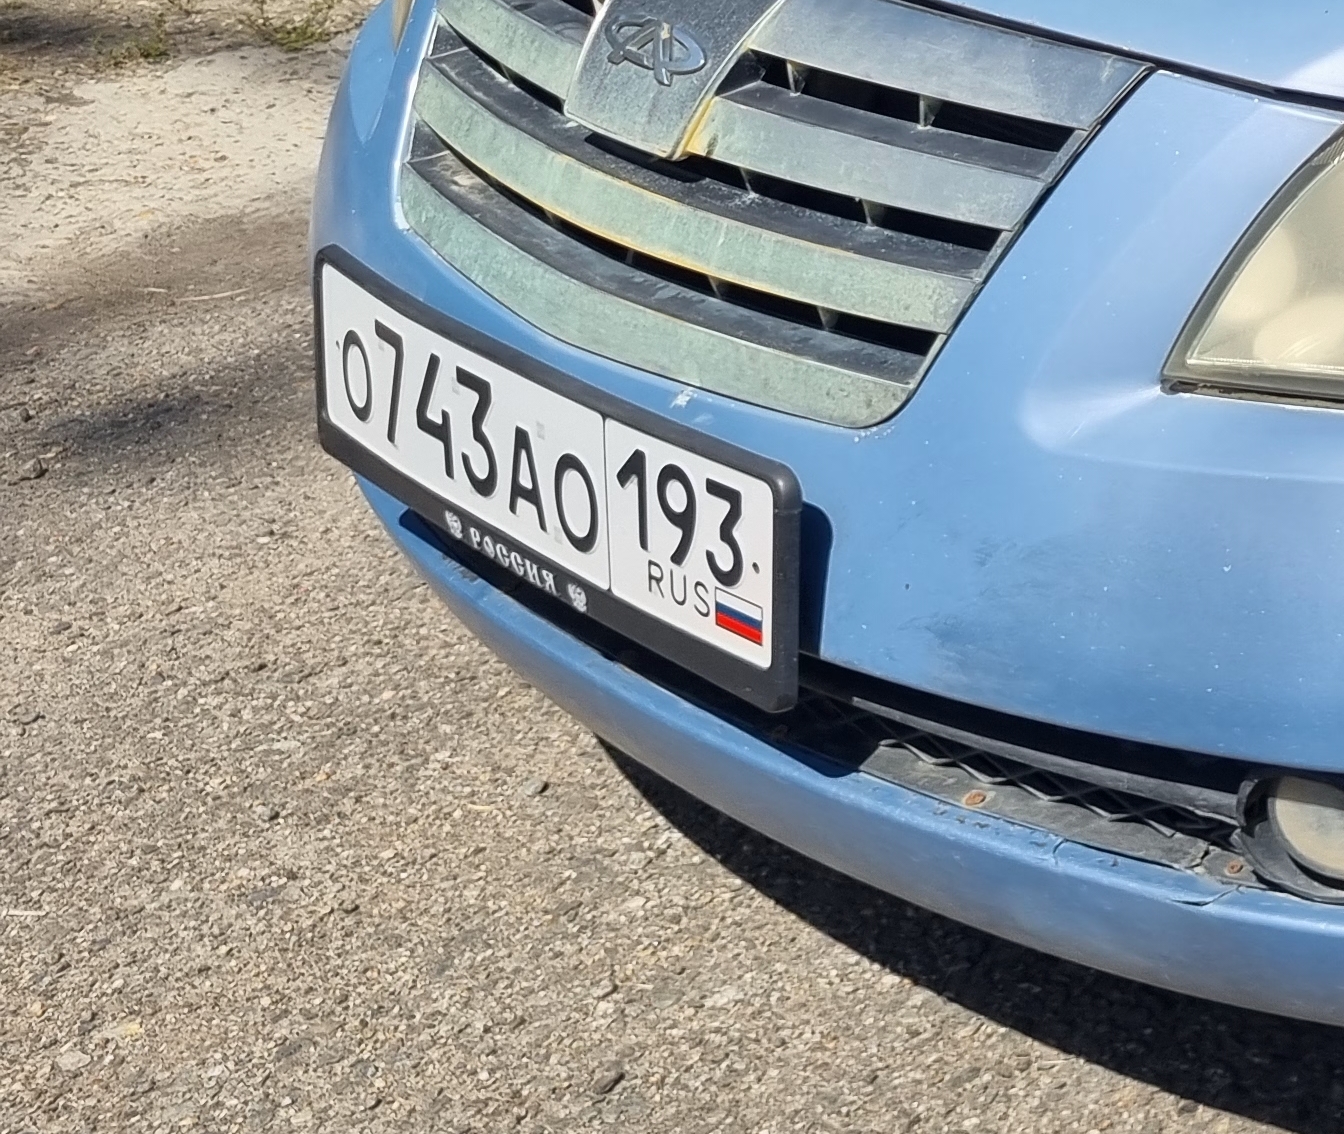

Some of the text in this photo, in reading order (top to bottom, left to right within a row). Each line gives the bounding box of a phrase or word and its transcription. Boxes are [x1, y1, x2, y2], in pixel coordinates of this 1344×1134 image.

[342, 318, 744, 588] О743АО 193
[469, 526, 560, 597] РОССИЯ
[648, 559, 710, 618] RUS
